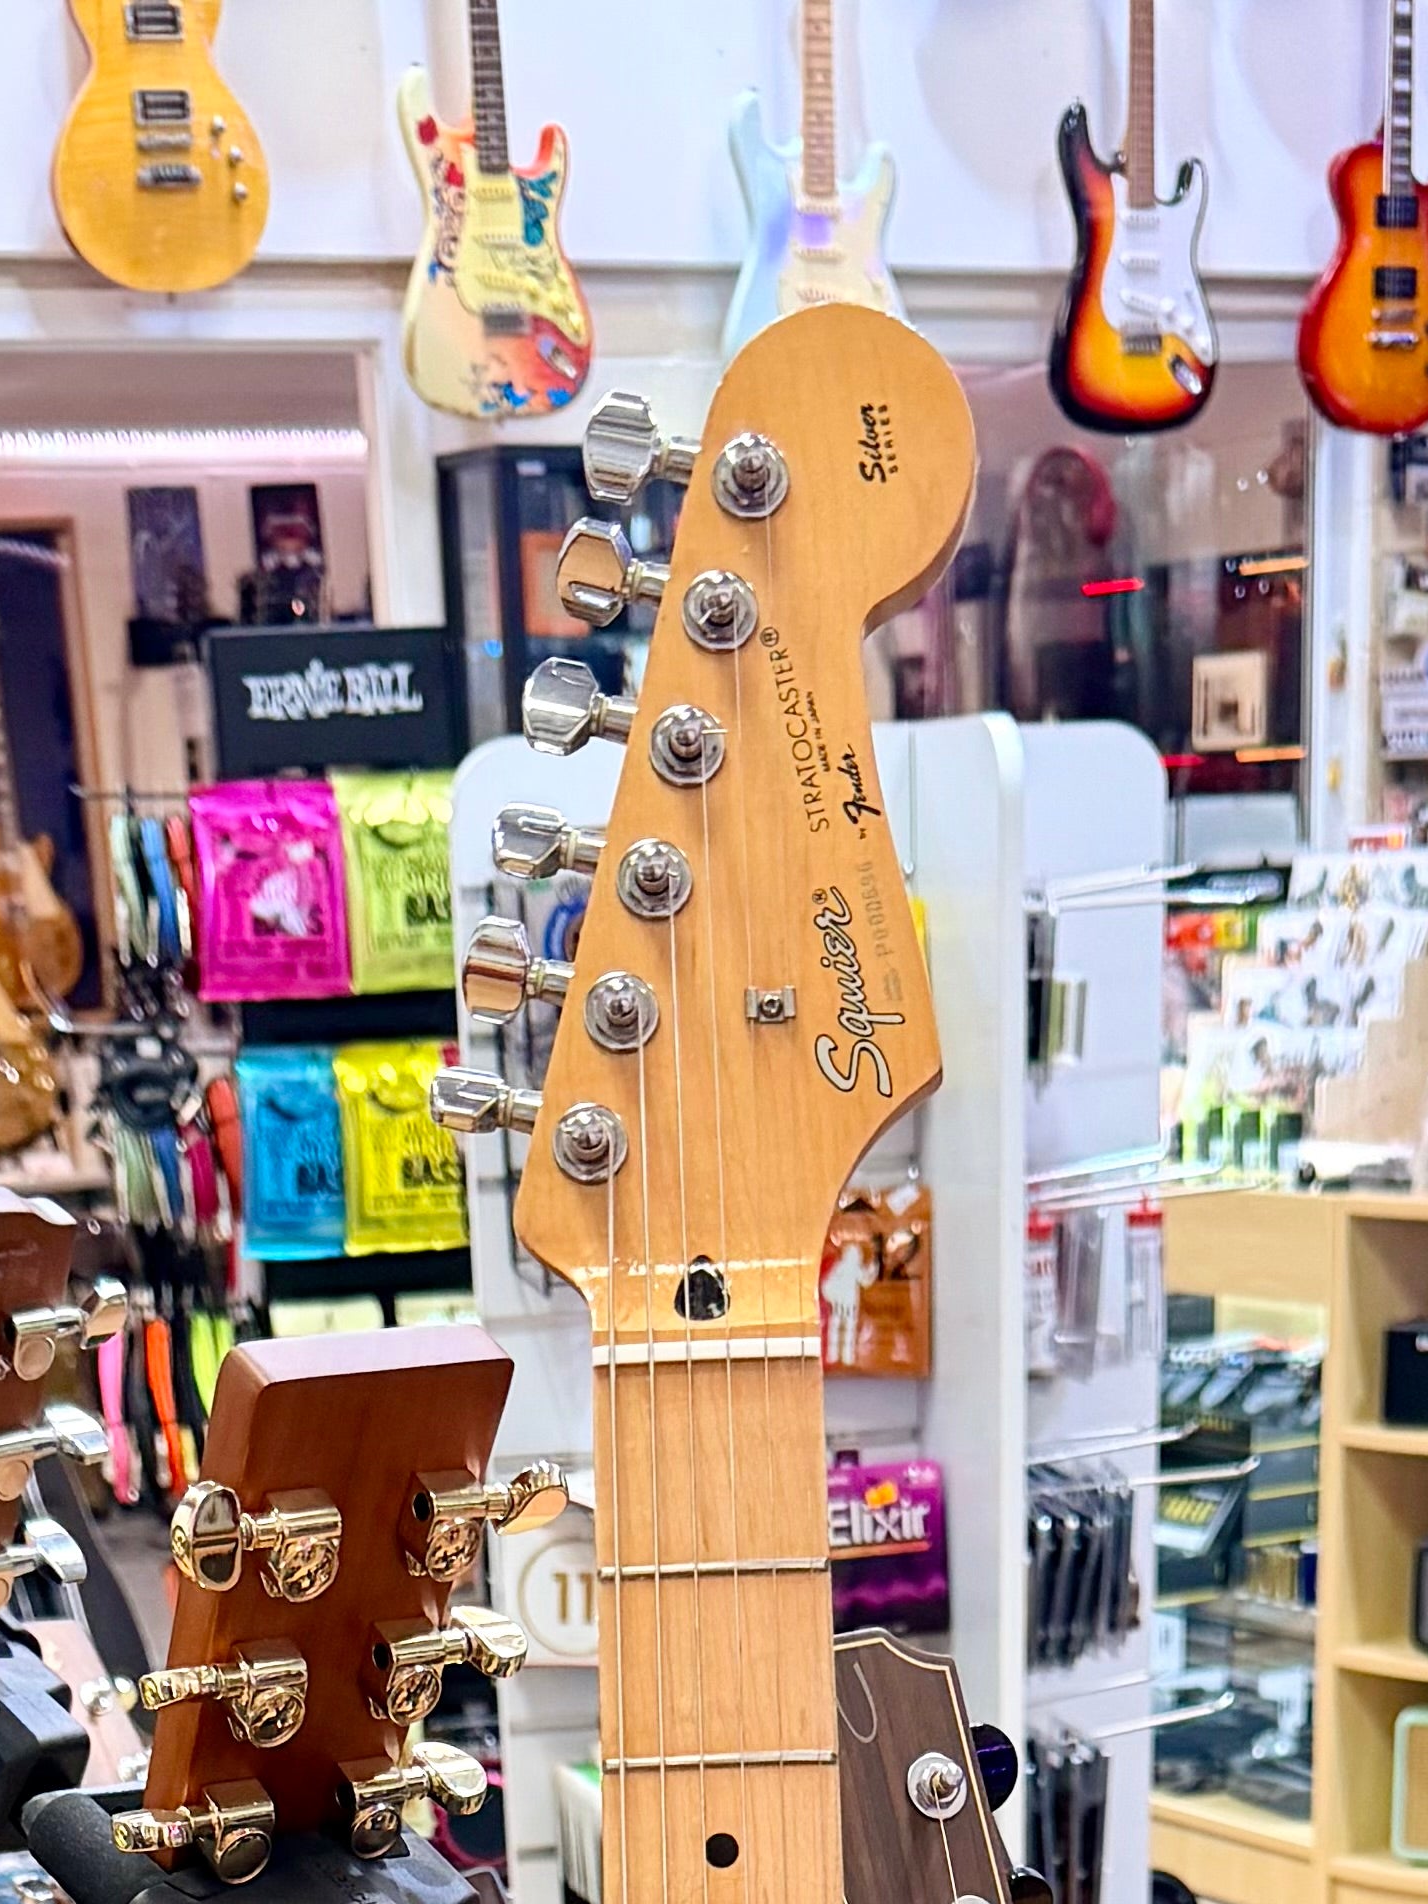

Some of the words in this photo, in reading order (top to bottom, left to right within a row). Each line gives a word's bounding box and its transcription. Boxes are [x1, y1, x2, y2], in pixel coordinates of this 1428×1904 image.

[858, 403, 887, 484] Silver
[878, 404, 899, 475] SERIES
[243, 657, 344, 720] ERNIE
[344, 661, 423, 717] BALL
[768, 647, 830, 833] STRATOCASTER
[817, 743, 831, 773] MADE
[837, 743, 881, 825] Fender
[813, 885, 906, 1099] Squier
[827, 1498, 931, 1546] Elixir
